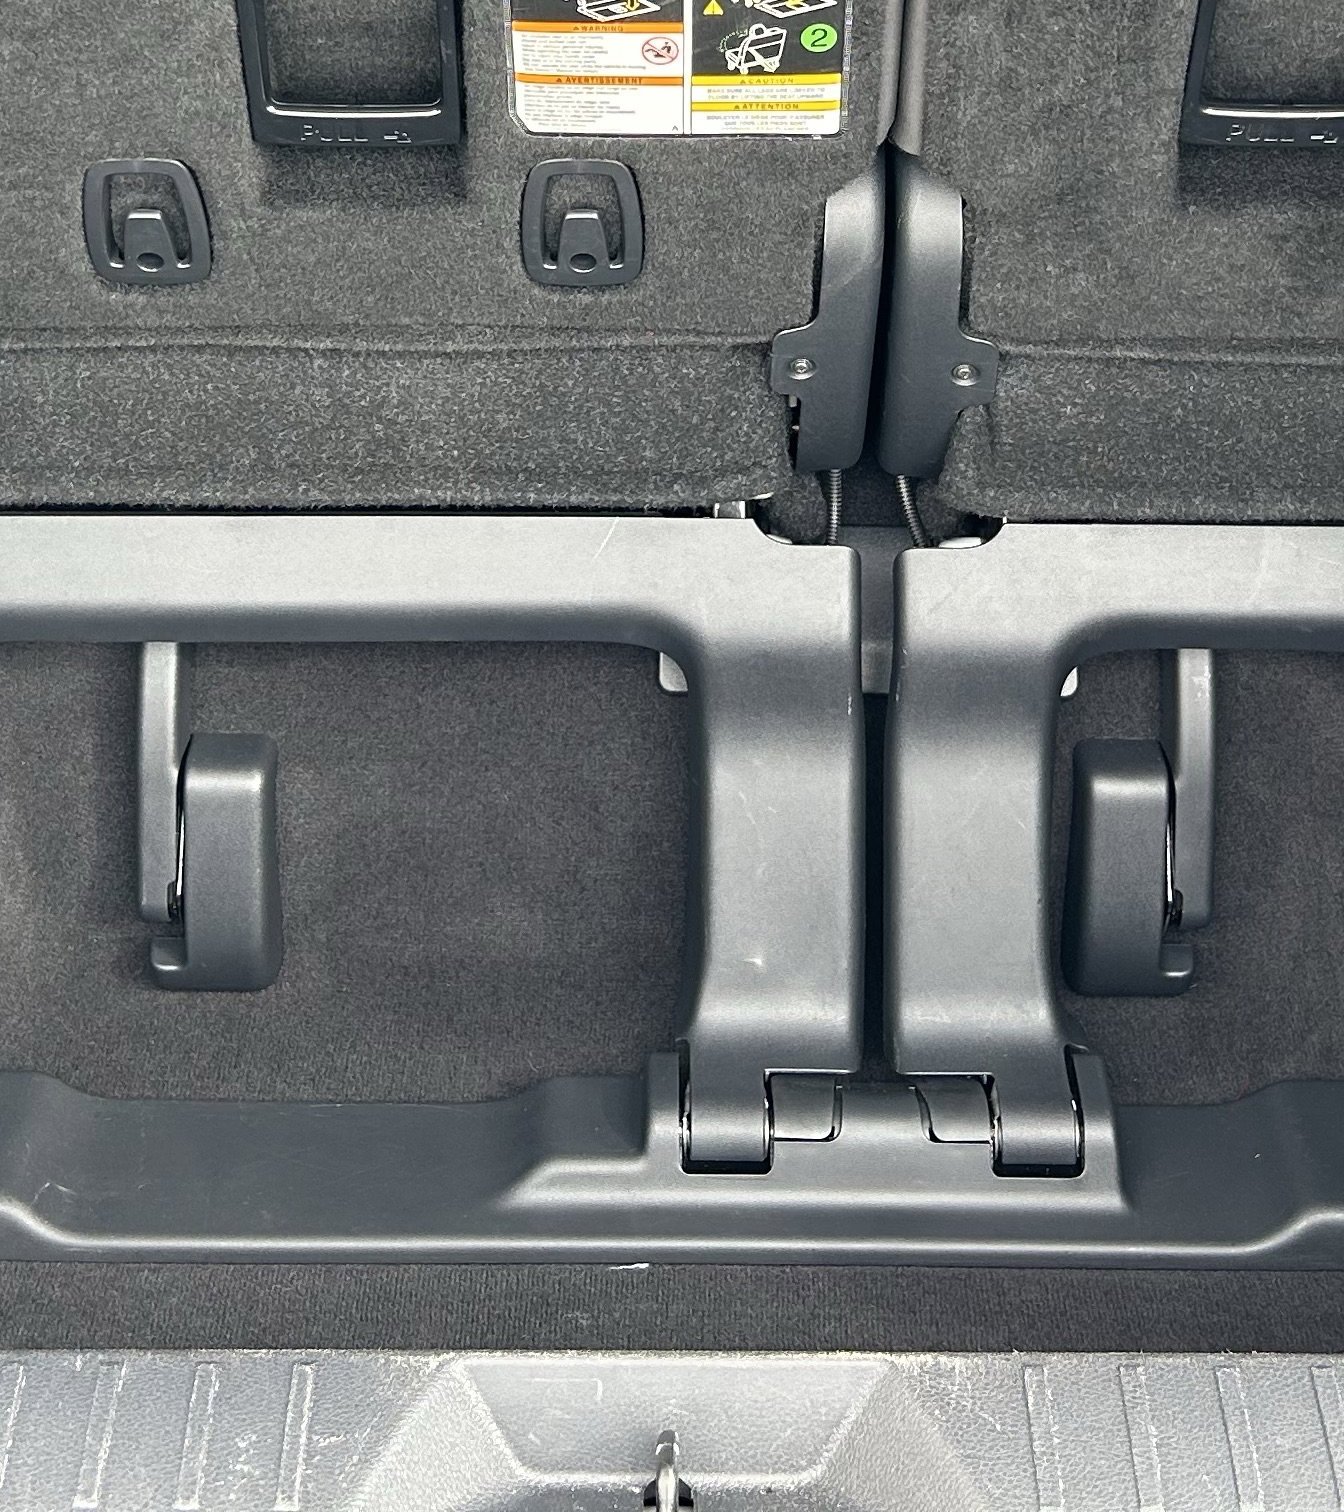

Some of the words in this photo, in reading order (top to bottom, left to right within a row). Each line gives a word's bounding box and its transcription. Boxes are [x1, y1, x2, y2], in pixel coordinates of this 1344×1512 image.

[581, 25, 624, 33] WARNING
[810, 28, 828, 47] 2
[565, 76, 643, 85] AVERTISSEMENT
[748, 77, 794, 85] CAUTION
